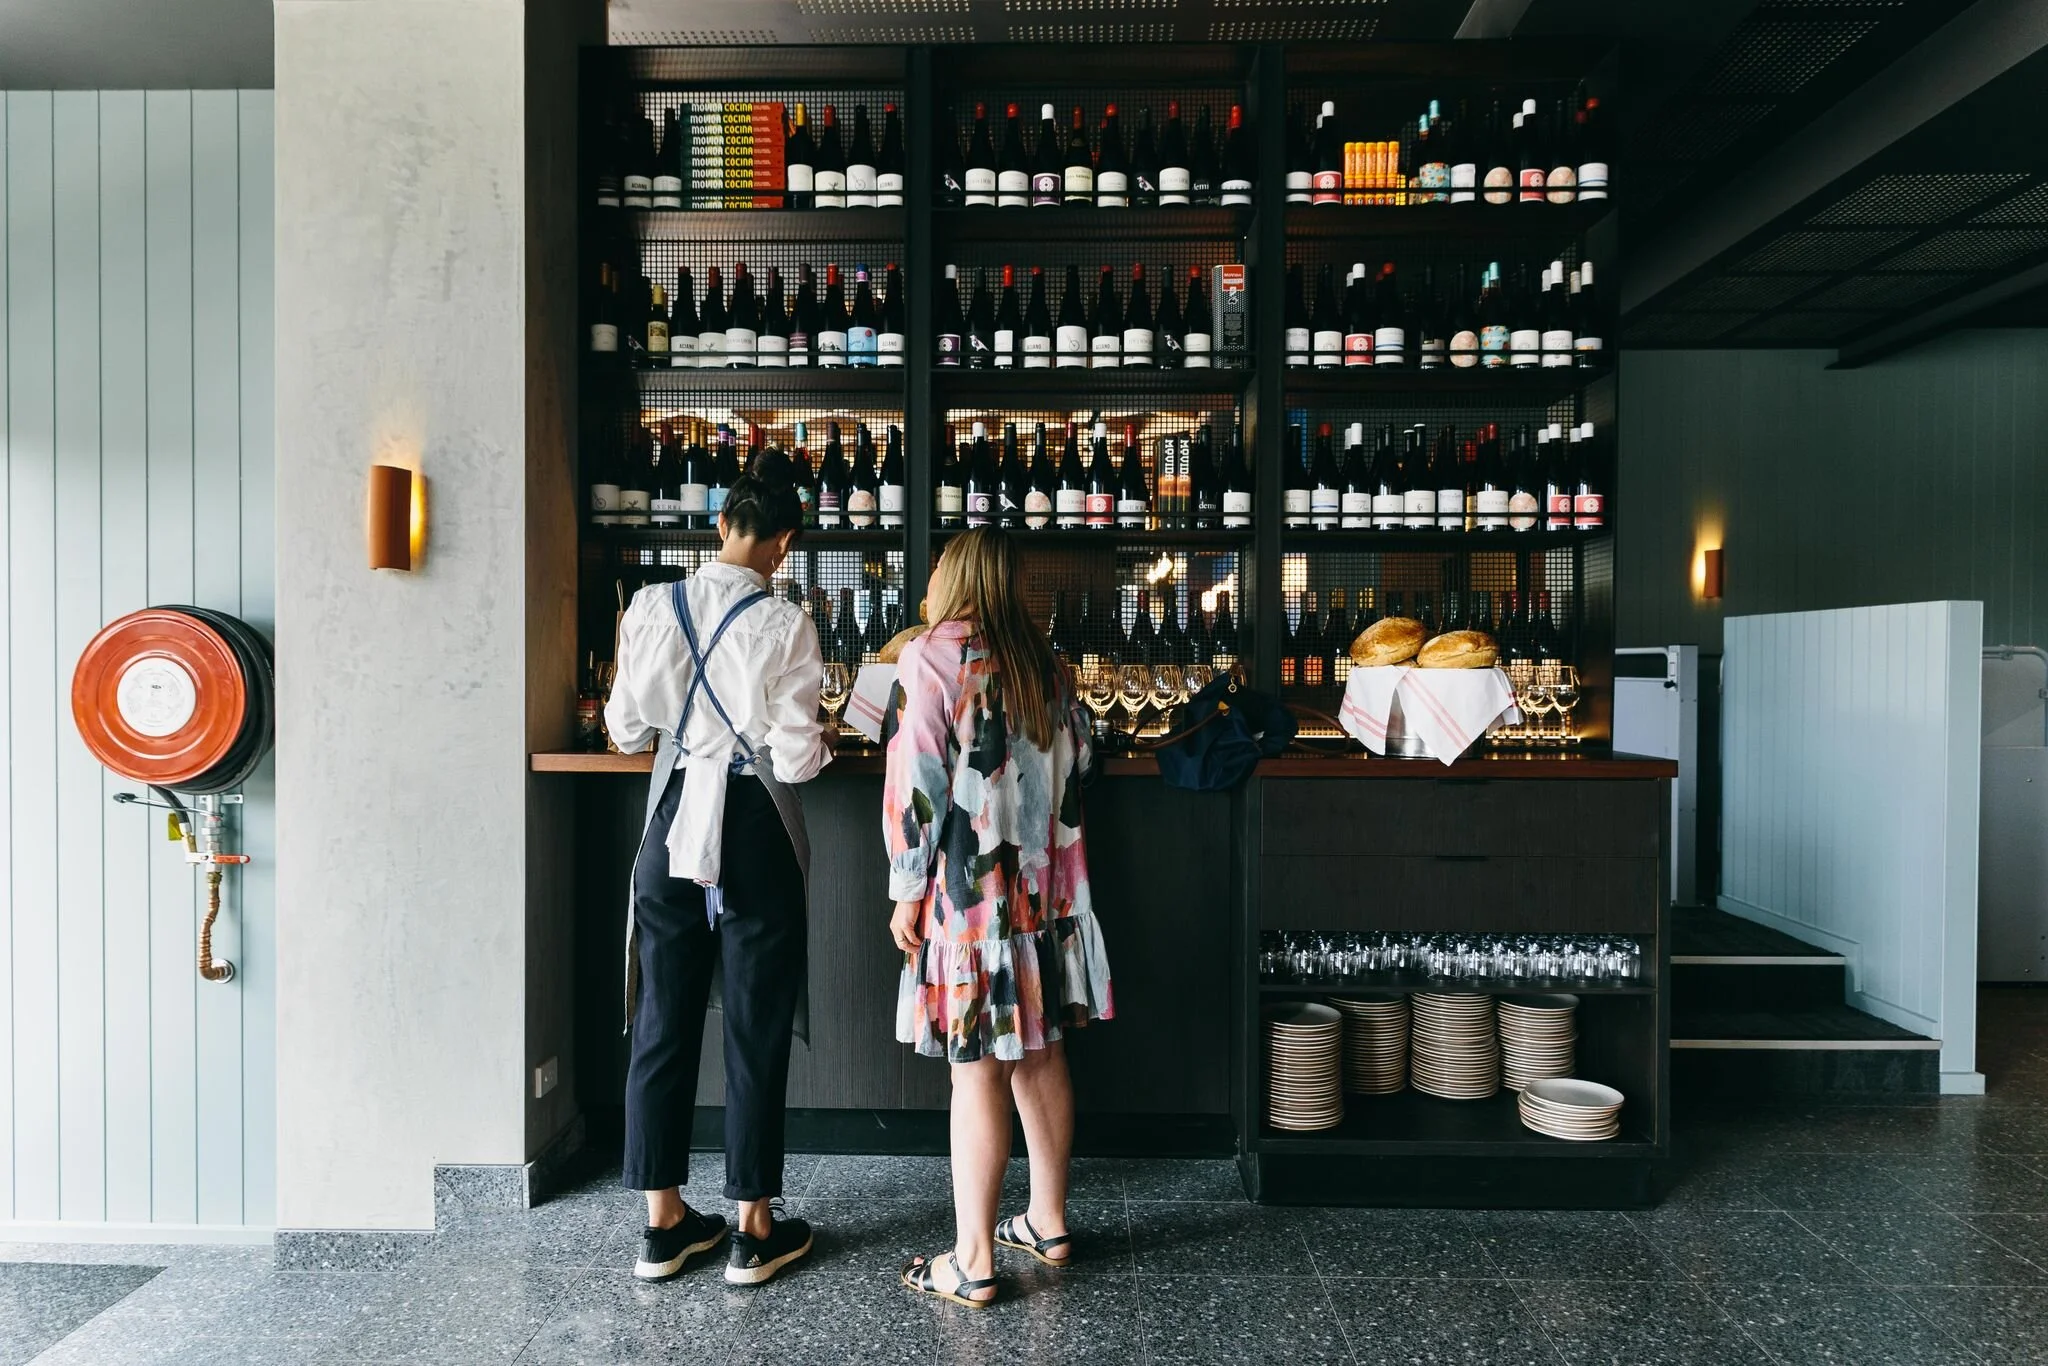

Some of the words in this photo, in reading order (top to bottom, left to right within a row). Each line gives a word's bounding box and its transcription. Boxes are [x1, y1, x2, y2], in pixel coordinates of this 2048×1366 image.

[692, 103, 722, 112] MOVIDA
[724, 103, 752, 112] COCINA
[690, 114, 721, 124] MOVIDA
[723, 114, 751, 124] COCINA
[691, 125, 722, 135] MOVIDA
[724, 125, 752, 135] COCINA
[693, 136, 724, 145] MOVIDA
[726, 136, 754, 145] COCINA
[692, 146, 723, 155] MOVIDA
[725, 146, 753, 155] COCINA
[692, 157, 723, 167] MOVIDA
[725, 157, 753, 167] COCINA
[692, 168, 723, 178] MOVIDA
[725, 168, 753, 178] COCINA
[692, 179, 723, 189] MOVIDA
[725, 179, 753, 189] COCINA
[1165, 439, 1174, 481] MOVIDA
[1180, 439, 1189, 481] MOVIDA
